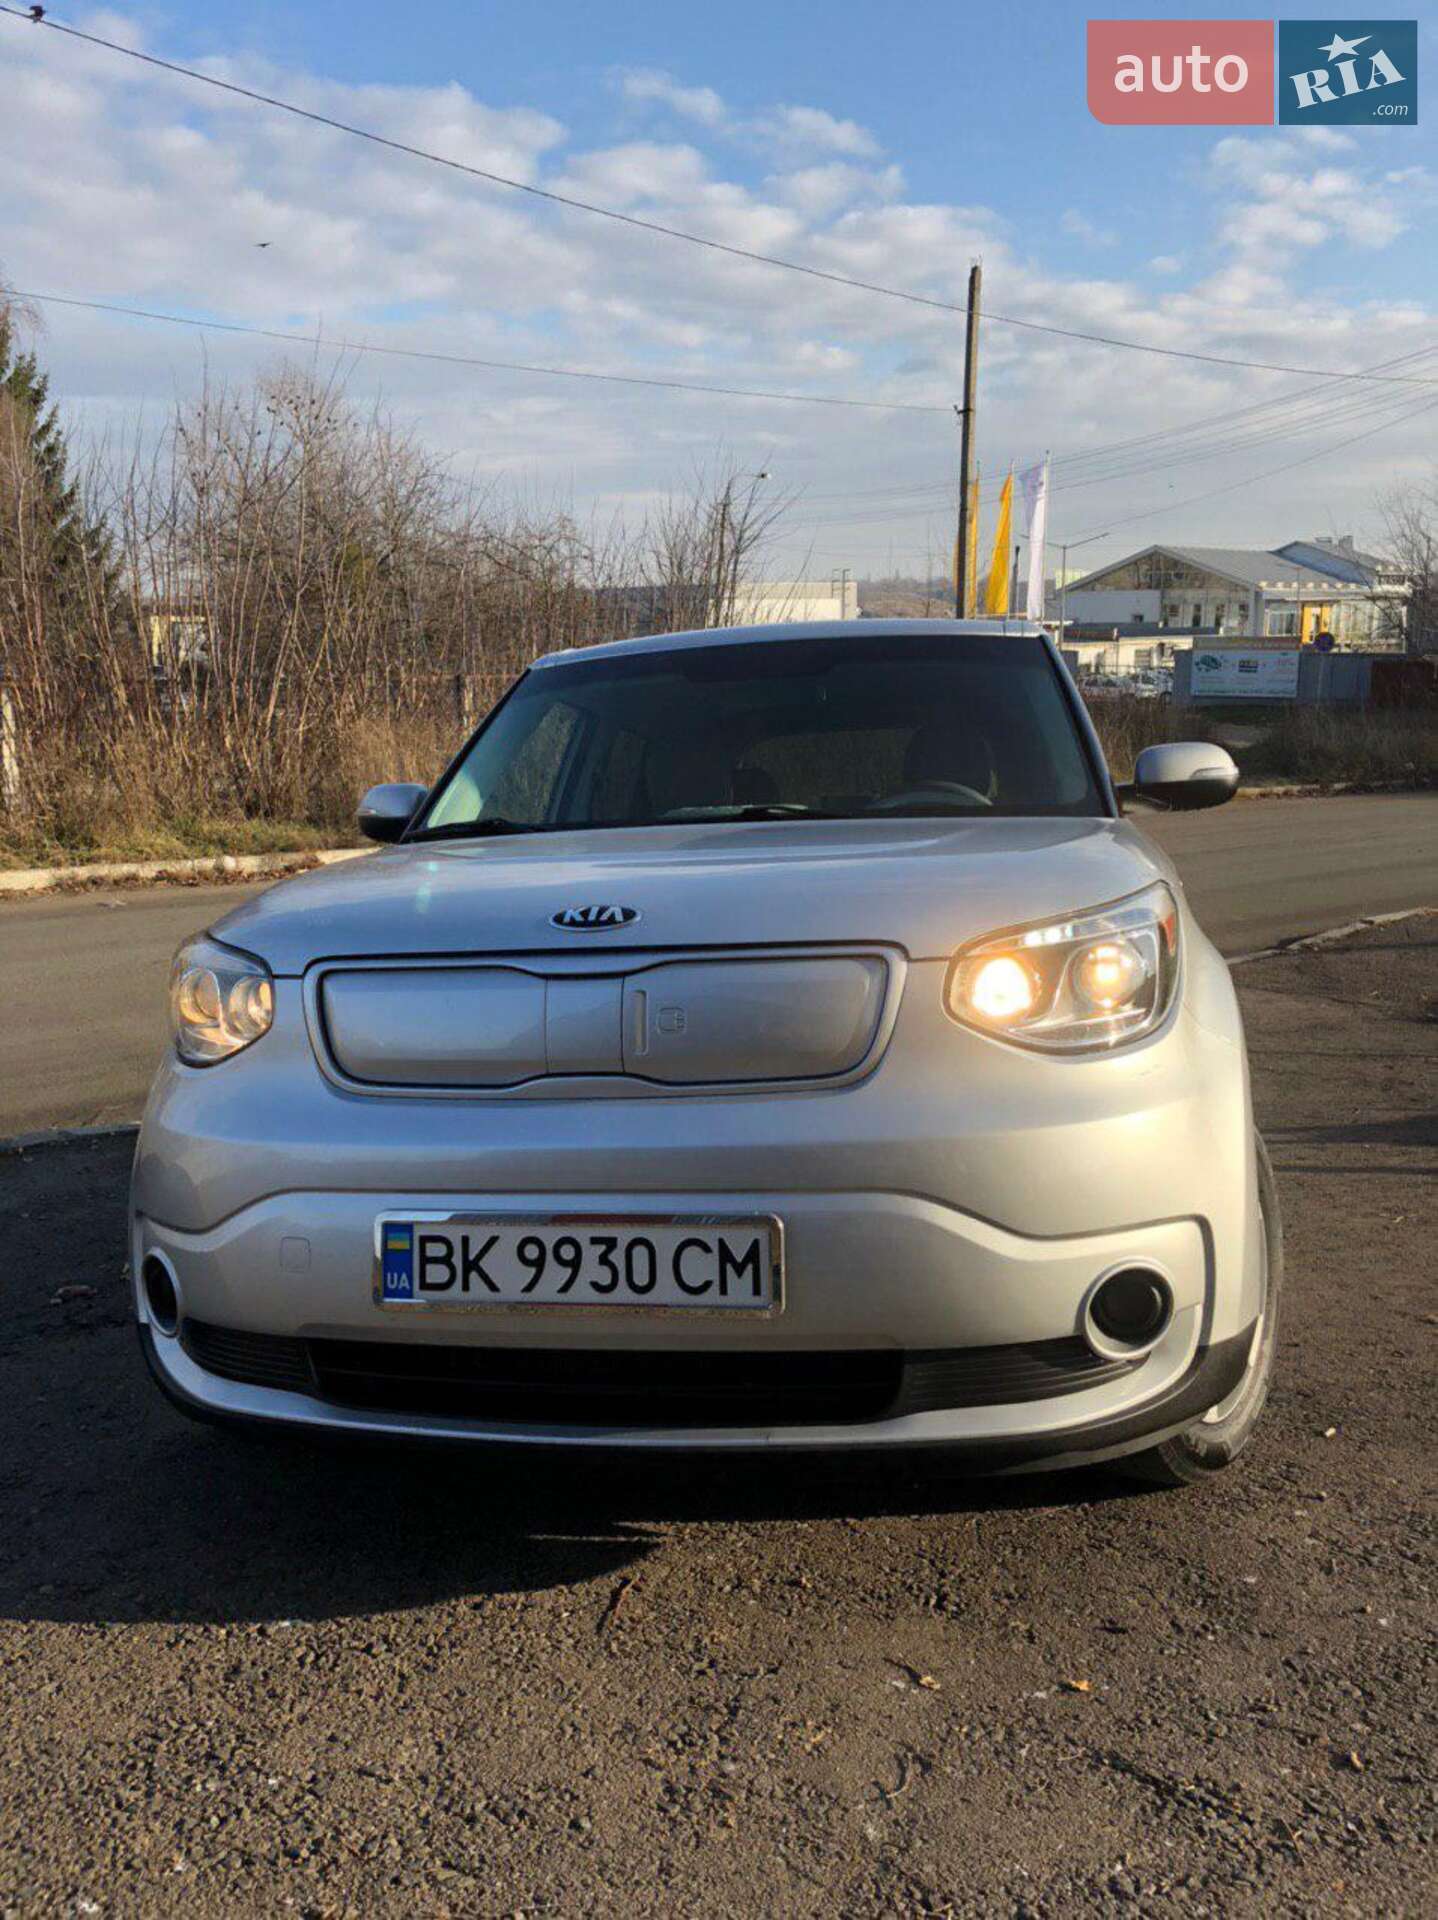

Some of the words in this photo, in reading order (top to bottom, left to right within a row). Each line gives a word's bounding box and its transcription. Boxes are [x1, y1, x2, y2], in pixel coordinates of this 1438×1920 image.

[562, 906, 624, 922] KIA
[418, 1234, 501, 1293] BK
[515, 1235, 657, 1295] 9930
[672, 1237, 762, 1296] CM
[386, 1271, 411, 1290] UA
